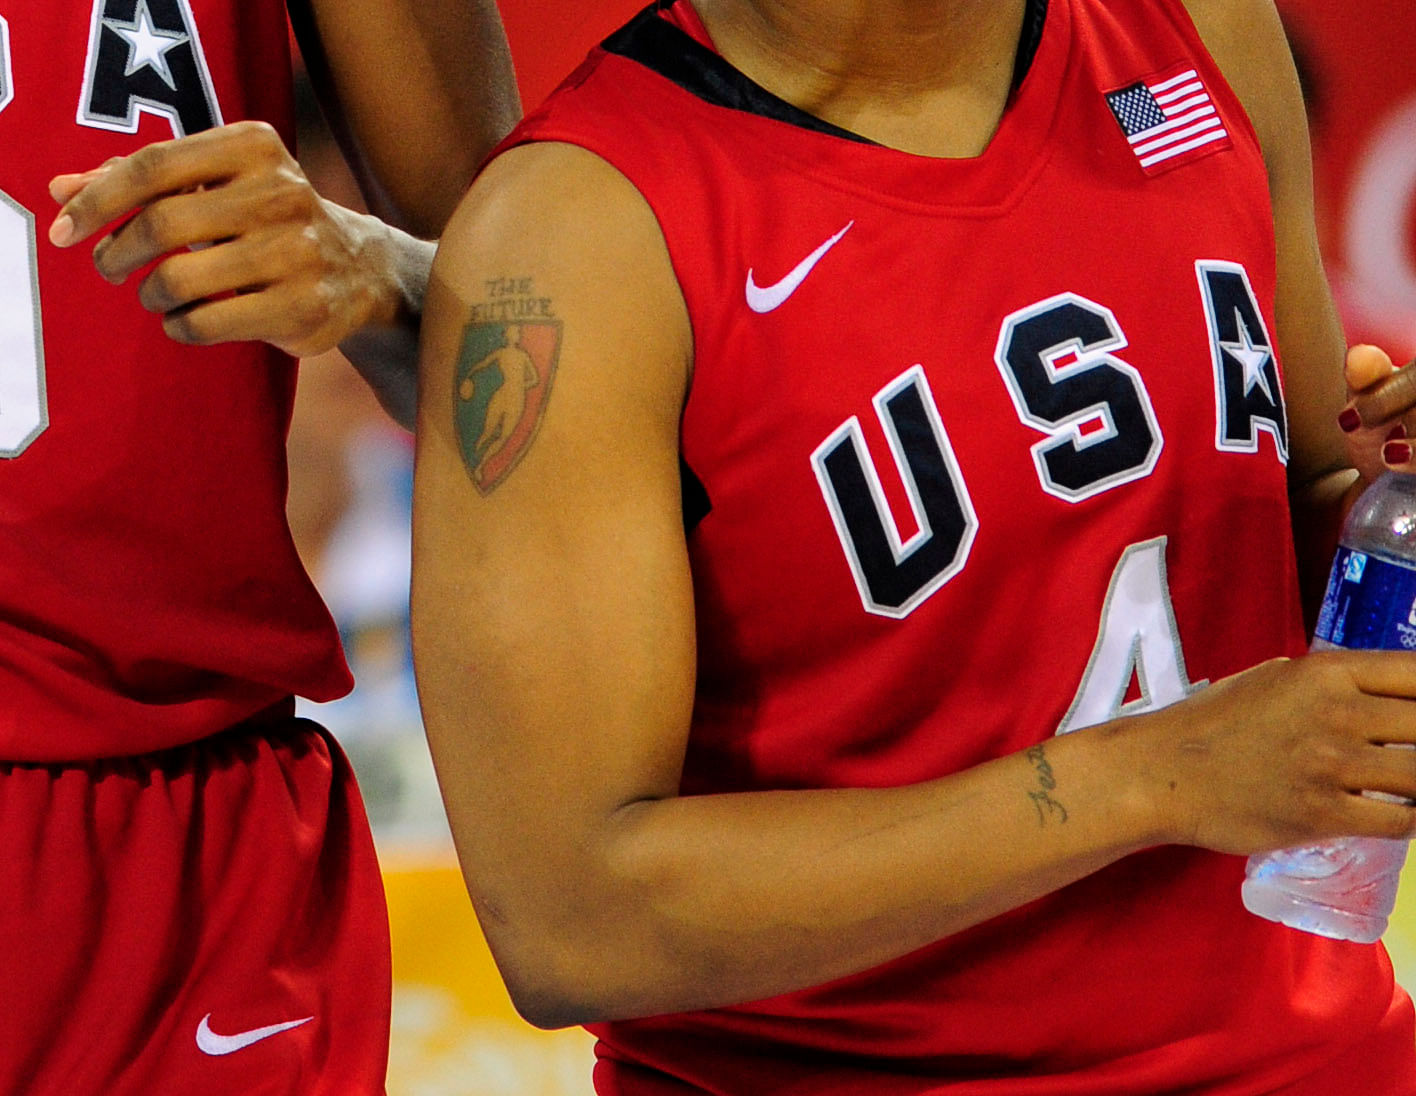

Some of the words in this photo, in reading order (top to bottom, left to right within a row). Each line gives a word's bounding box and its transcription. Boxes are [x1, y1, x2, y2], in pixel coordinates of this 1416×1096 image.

[470, 297, 555, 322] FUTURE
[485, 276, 533, 297] THE
[810, 259, 1289, 620] USA
[1055, 535, 1211, 737] 4
